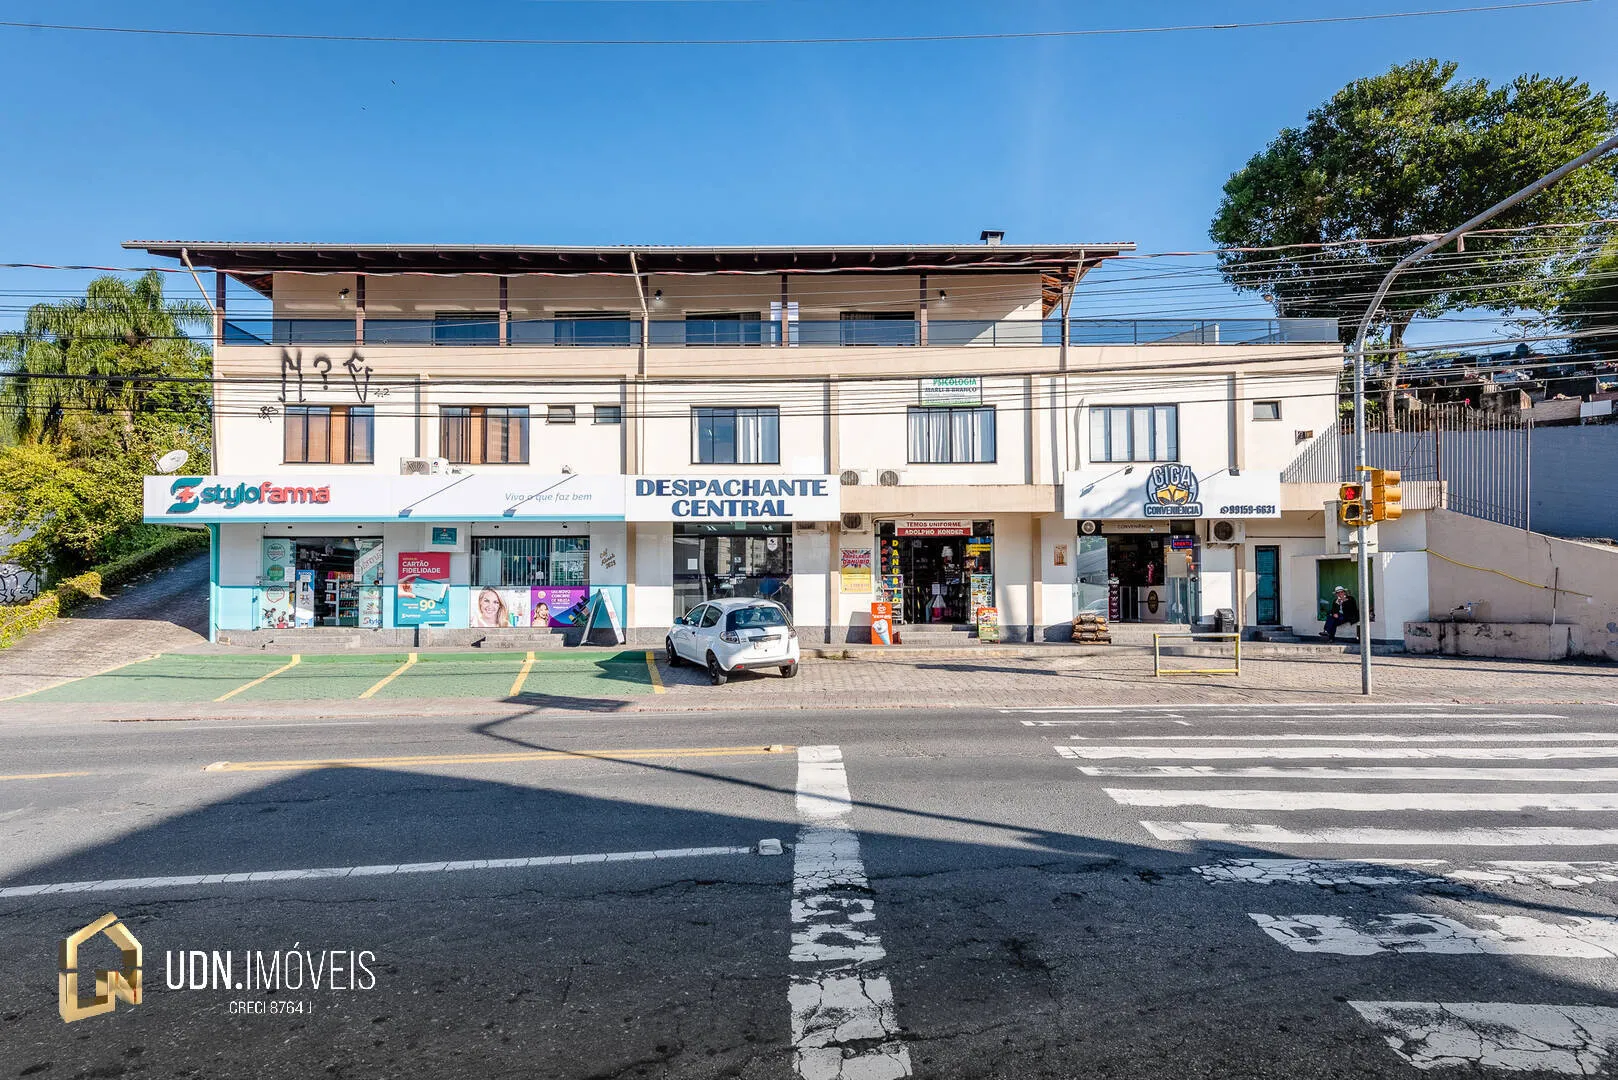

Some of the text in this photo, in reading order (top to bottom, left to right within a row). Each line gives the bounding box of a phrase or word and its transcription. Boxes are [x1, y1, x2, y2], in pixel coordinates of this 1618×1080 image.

[932, 378, 977, 387] PSICOLOGIA
[1152, 465, 1193, 486] GIGA
[635, 479, 829, 497] DESPACHANTE
[536, 494, 553, 503] que
[555, 492, 570, 503] faz
[572, 492, 592, 501] bem
[671, 499, 793, 517] CENTRAL
[1229, 505, 1276, 515] 99159-6631
[402, 559, 429, 567] CARTÃO
[419, 599, 436, 612] 90
